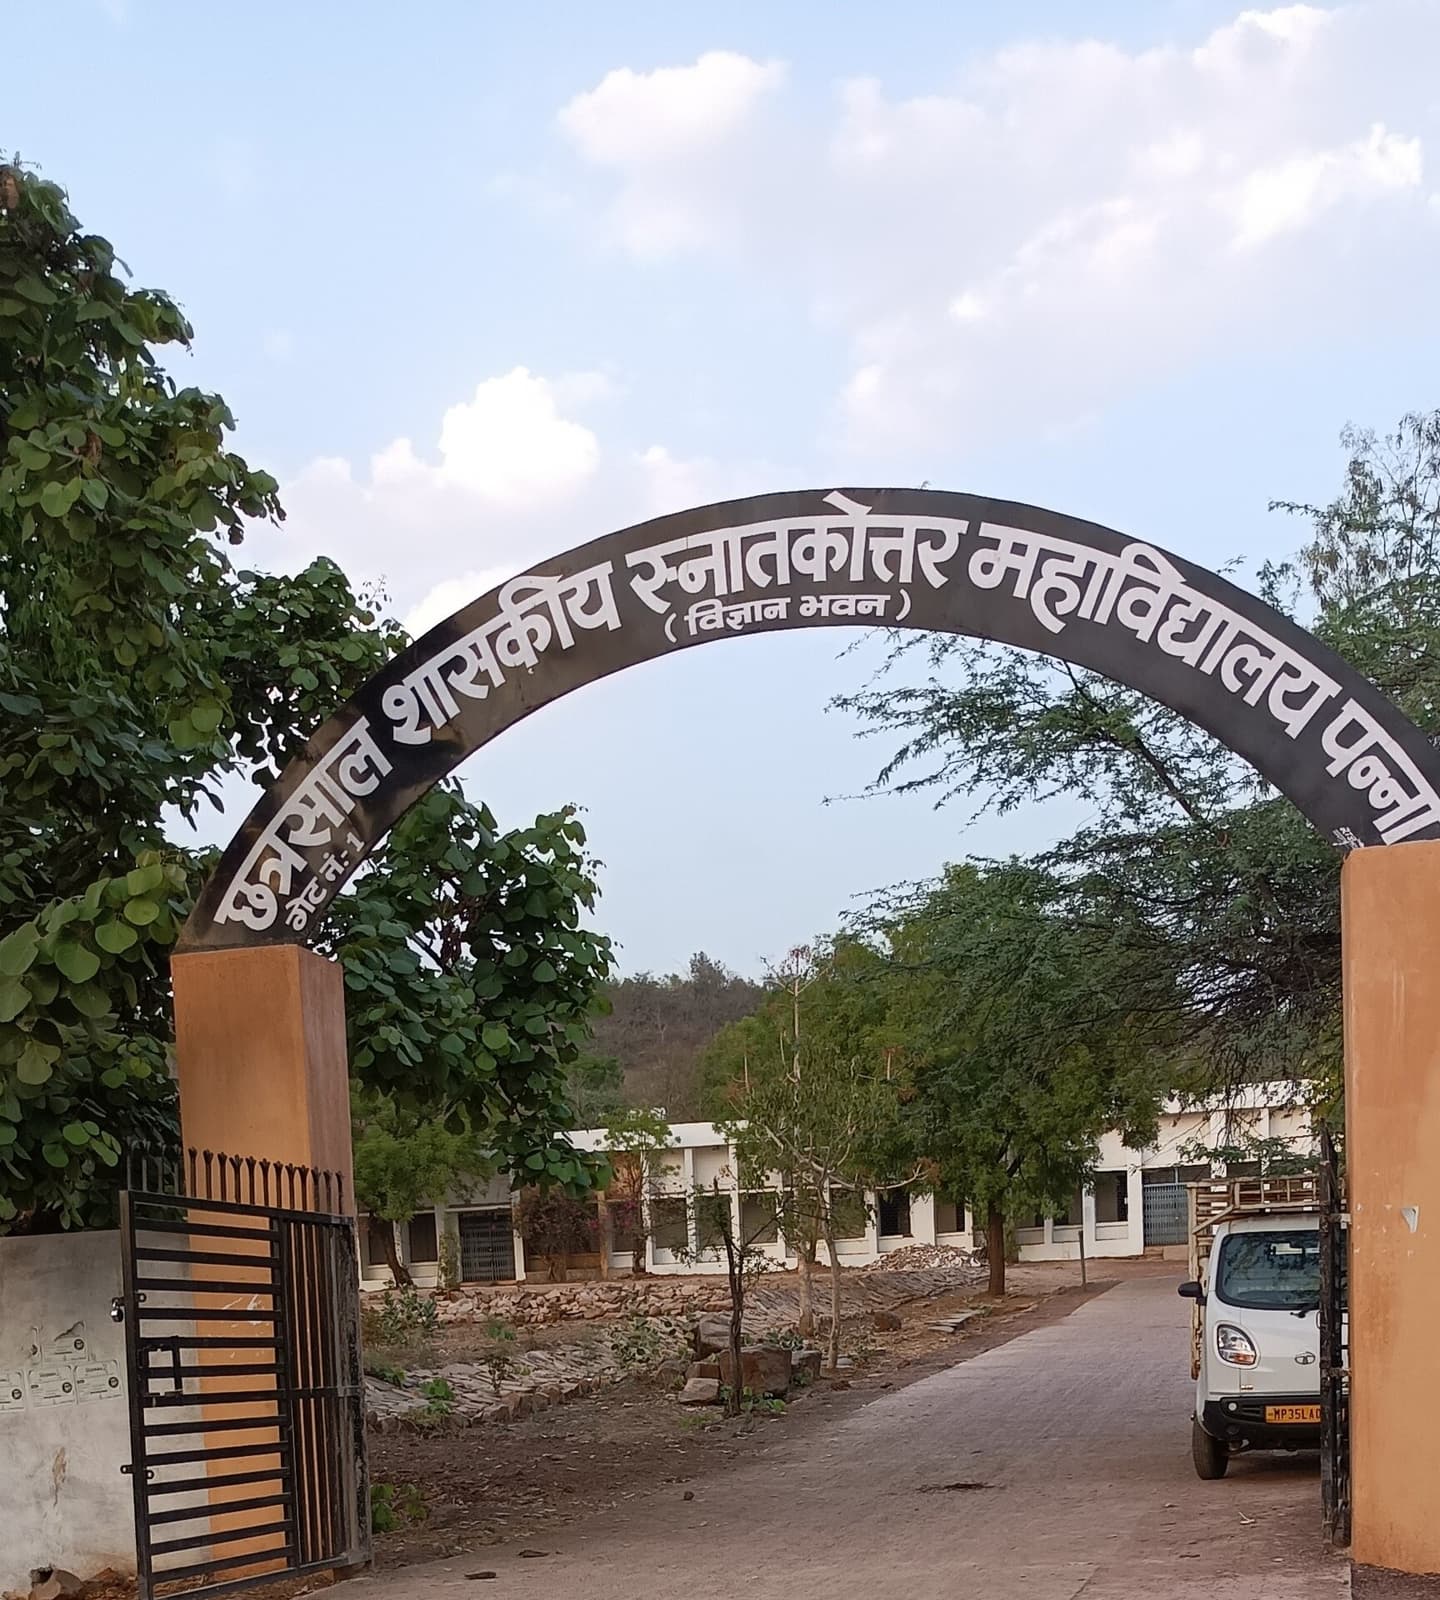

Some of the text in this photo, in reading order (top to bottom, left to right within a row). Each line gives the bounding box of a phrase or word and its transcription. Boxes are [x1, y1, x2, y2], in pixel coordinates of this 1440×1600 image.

[213, 490, 1440, 931] छत्रसाल शासकीय स्नातकोत्तर महाविद्यालय पन्ना
[285, 876, 327, 931] गेट
